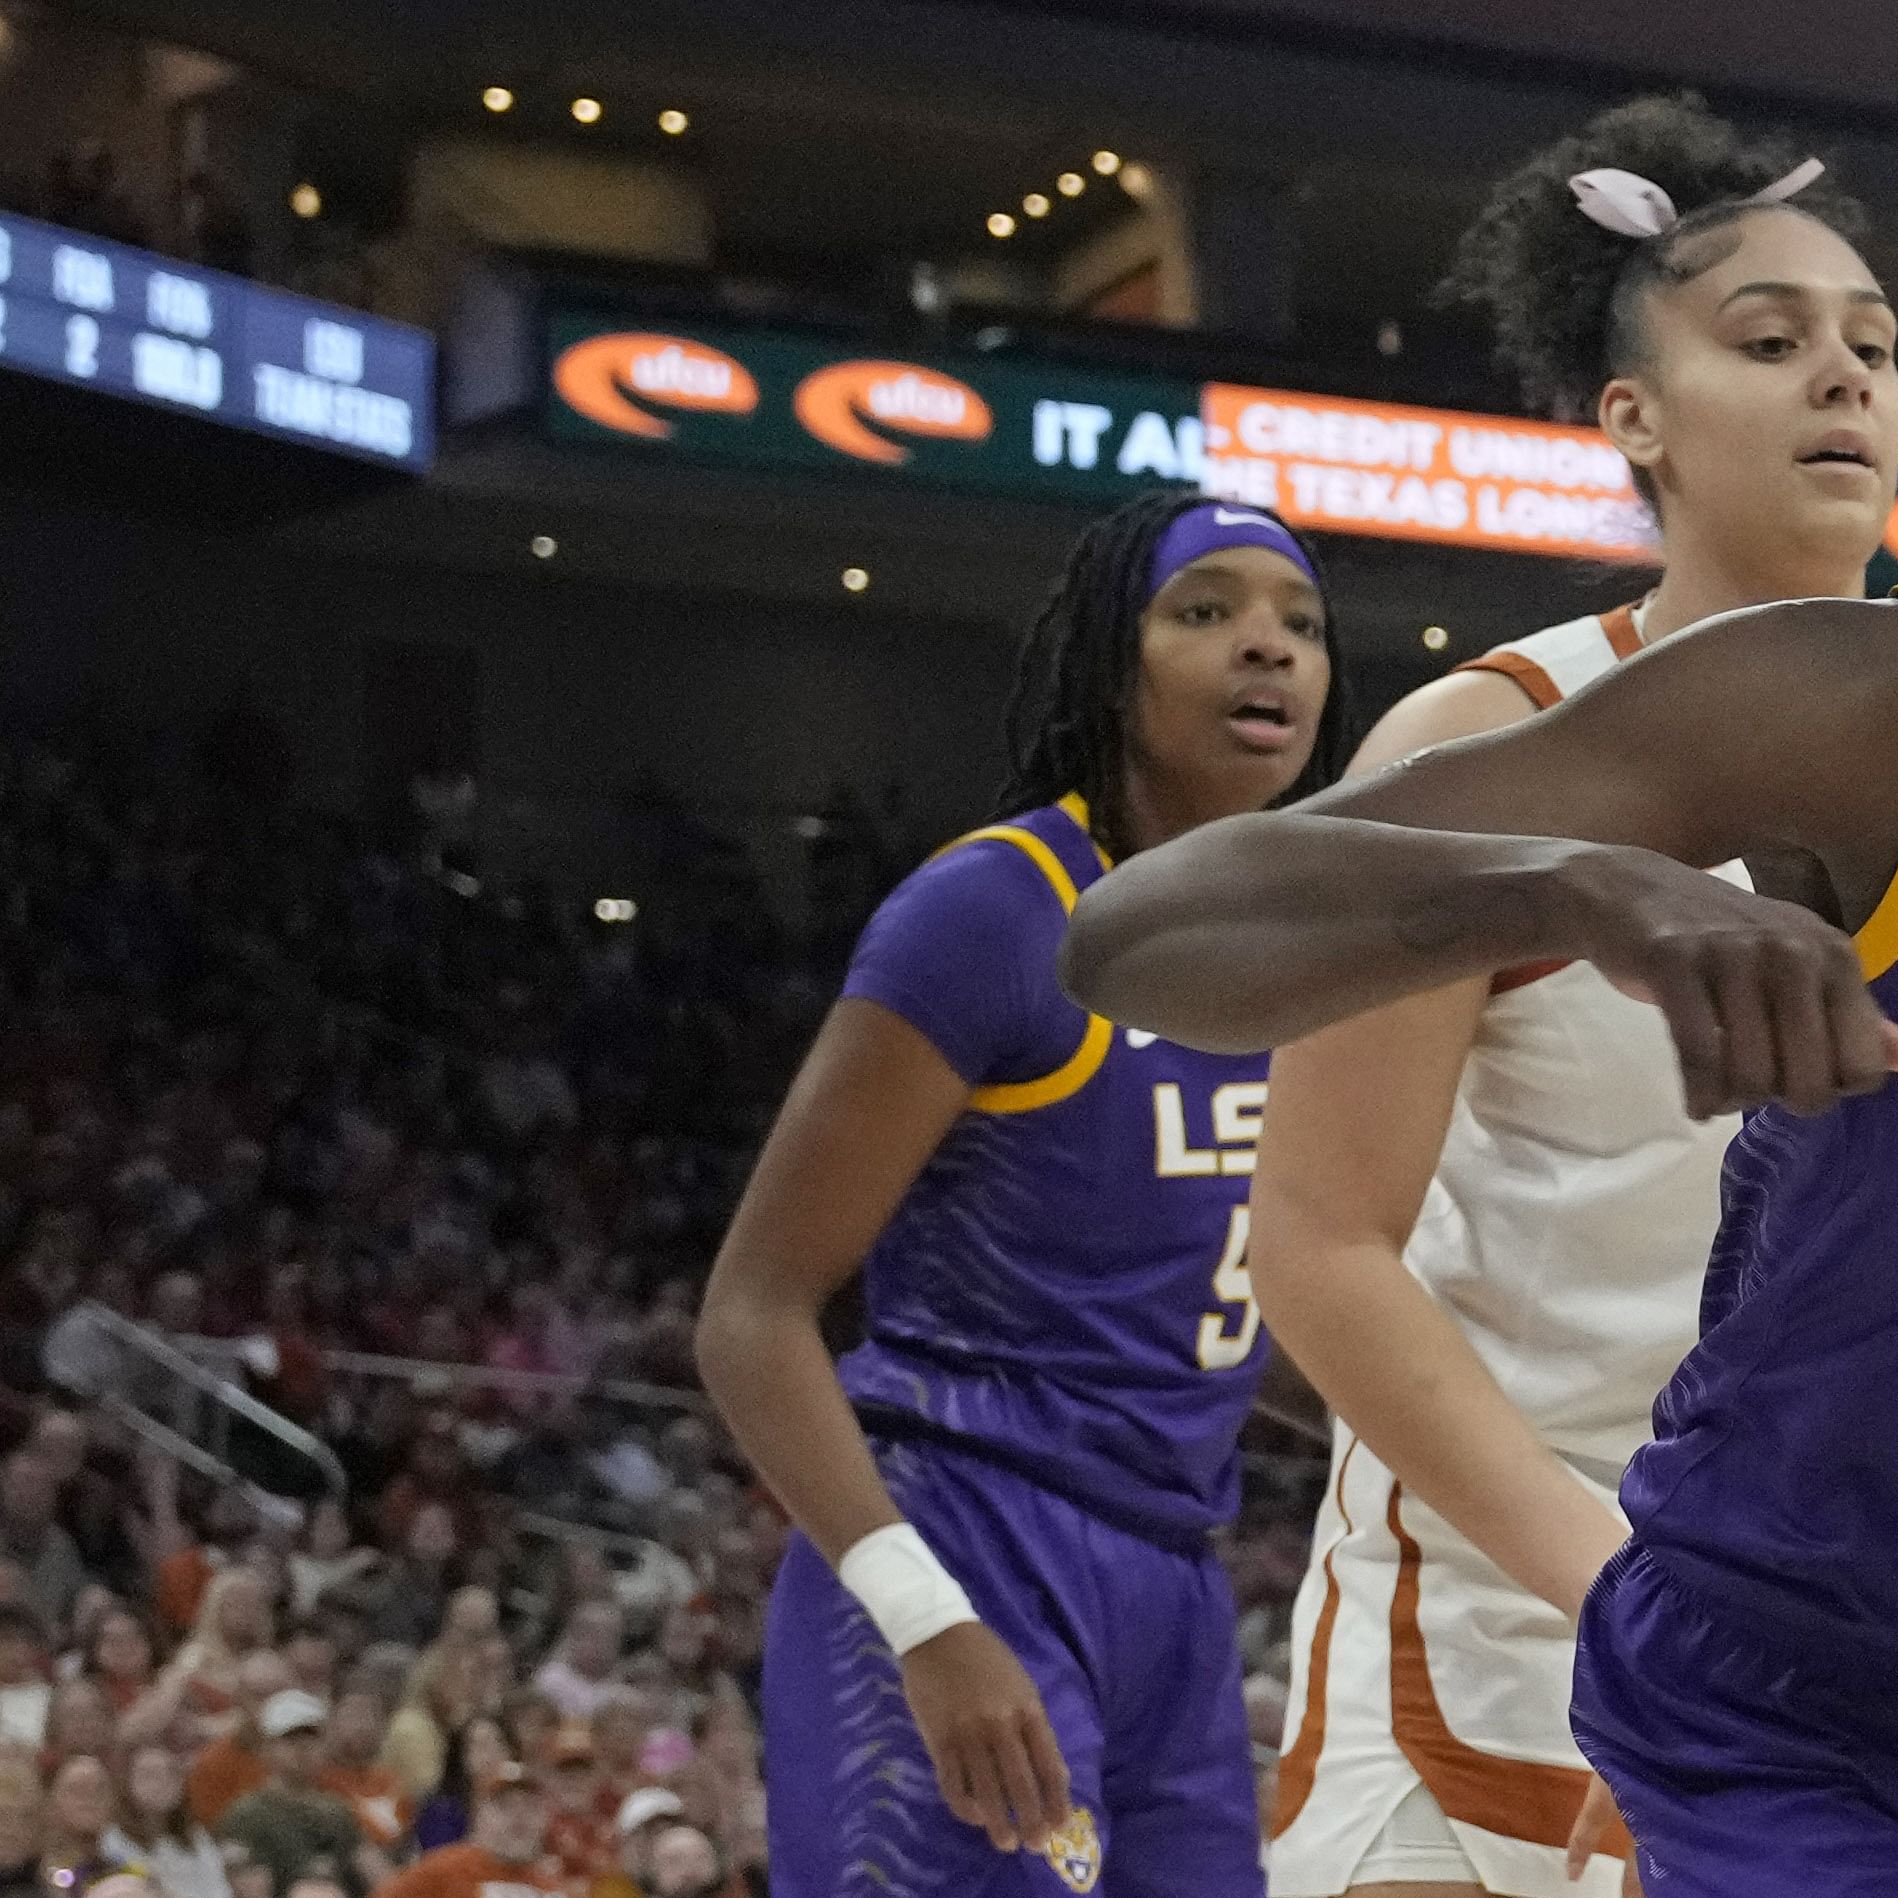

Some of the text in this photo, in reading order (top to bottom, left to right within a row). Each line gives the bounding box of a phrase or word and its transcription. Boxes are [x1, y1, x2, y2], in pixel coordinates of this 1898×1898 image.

[1033, 400, 1112, 470] IT
[1238, 402, 1442, 471] CREDIT
[1288, 462, 1467, 531] TEXAS
[1153, 1081, 1270, 1179] LS
